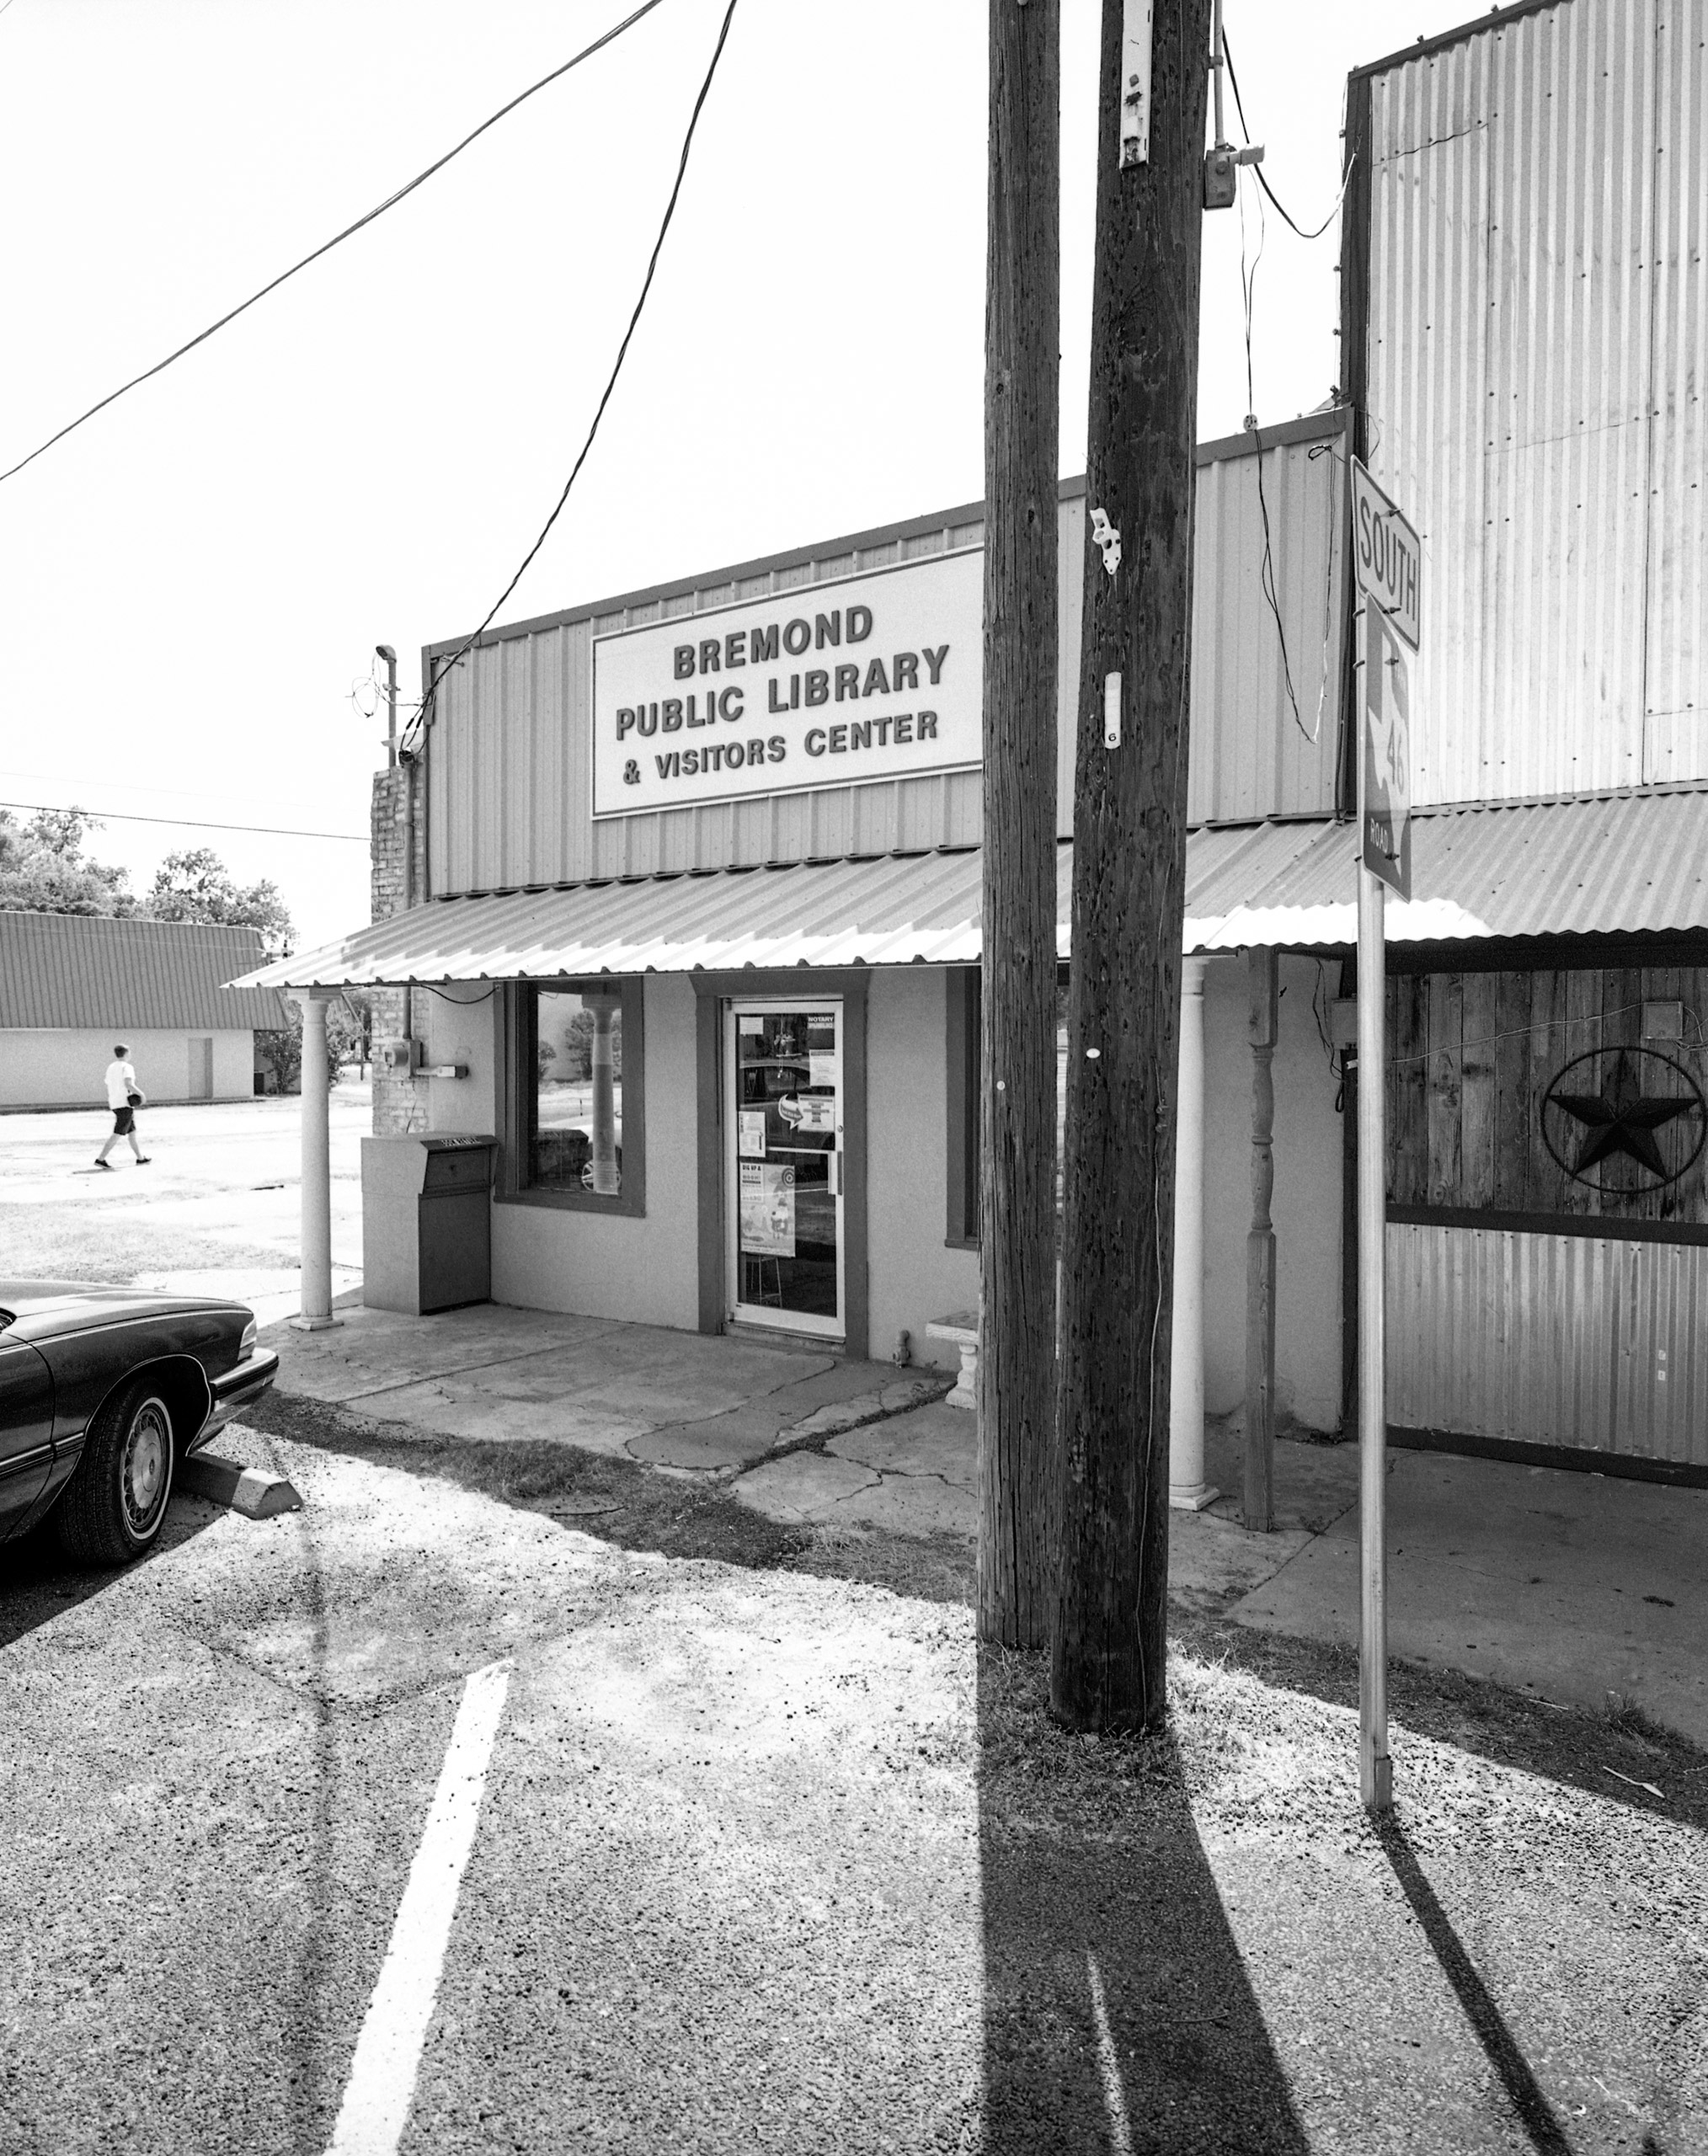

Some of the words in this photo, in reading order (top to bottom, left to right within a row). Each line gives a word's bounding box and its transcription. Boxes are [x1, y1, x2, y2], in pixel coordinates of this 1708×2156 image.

[1360, 496, 1417, 622] SOUTH
[674, 605, 873, 680] BREMOND
[616, 686, 744, 740] PUBLIC
[768, 644, 950, 713] LIBRARY
[623, 759, 640, 784] &
[655, 736, 786, 778] VISITORS
[804, 710, 938, 756] CENTER
[1108, 733, 1117, 741] 6
[1386, 719, 1405, 795] 46
[1369, 817, 1389, 853] ROAD
